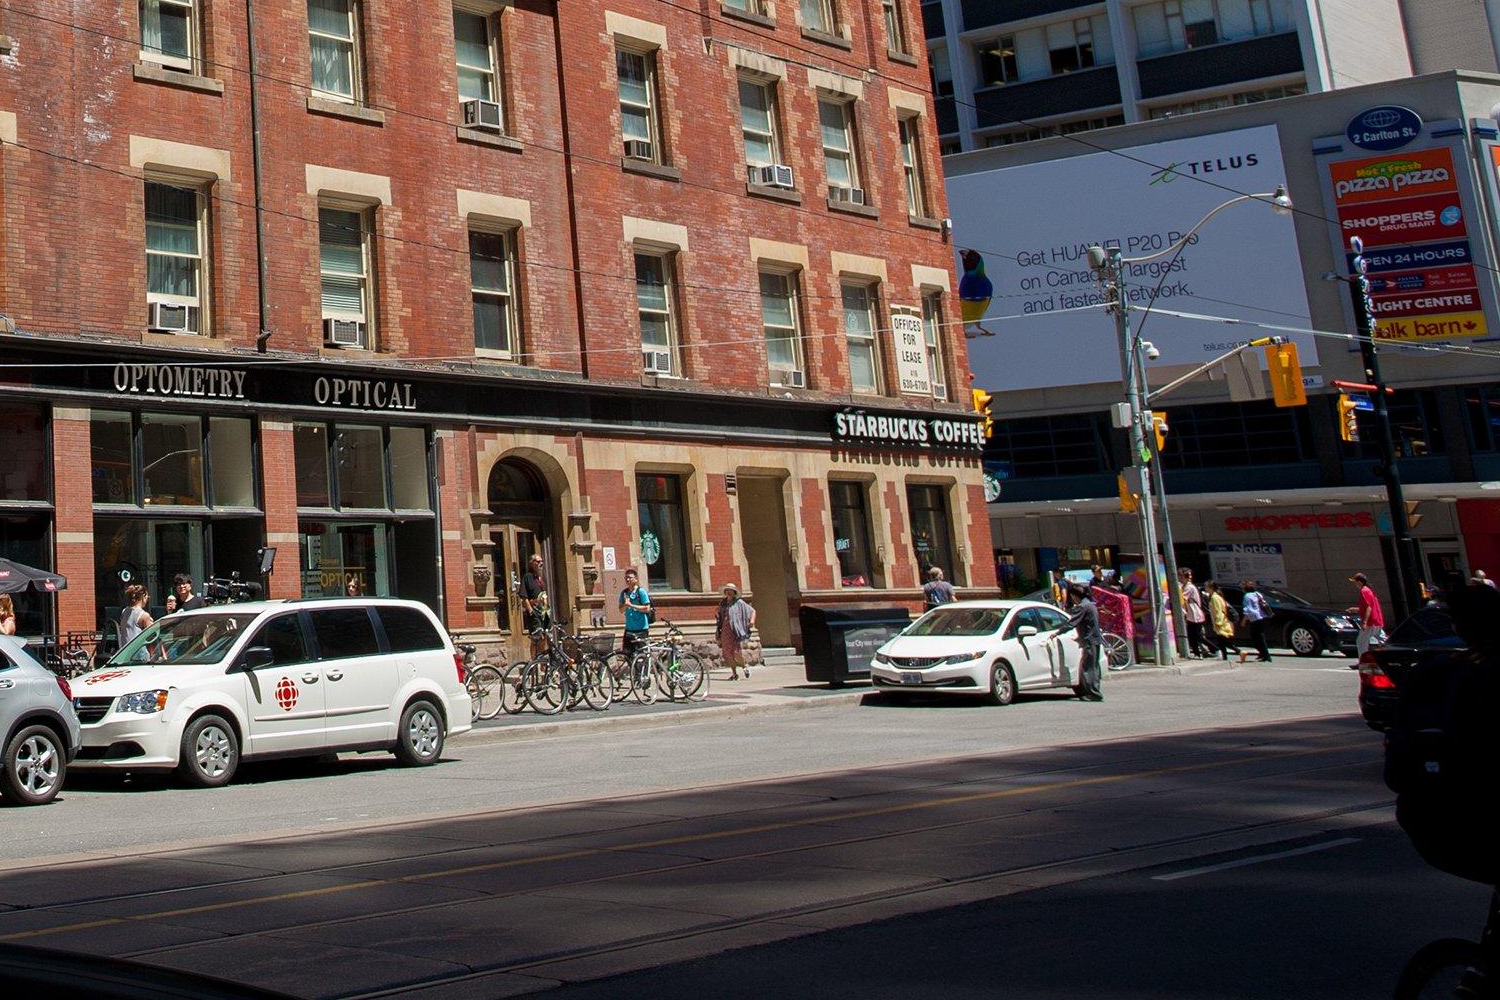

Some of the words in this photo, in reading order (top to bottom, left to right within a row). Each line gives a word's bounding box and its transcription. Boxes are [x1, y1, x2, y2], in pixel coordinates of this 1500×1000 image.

[1353, 134, 1360, 143] 2
[1363, 128, 1399, 143] Carlton
[1402, 127, 1416, 138] St.
[1188, 153, 1258, 175] TELUS
[1355, 167, 1378, 178] Hot
[1388, 160, 1421, 173] Fresh
[1342, 210, 1436, 229] SHOPPERS
[1379, 223, 1407, 232] DRUG
[1408, 220, 1436, 229] MART
[1016, 250, 1046, 268] Get
[1127, 234, 1162, 252] P20
[1365, 256, 1391, 266] PEN
[1395, 254, 1411, 263] 24
[1414, 248, 1466, 261] HOURS
[1020, 276, 1041, 290] on
[1128, 256, 1187, 278] largest
[1023, 294, 1053, 313] and
[1369, 300, 1412, 313] LIGHT
[1414, 295, 1473, 309] CENTRE
[894, 317, 921, 332] OFFICES
[1376, 322, 1408, 339] ulk
[1413, 320, 1461, 337] barn
[903, 333, 916, 346] FOR
[902, 351, 922, 364] LEASE
[113, 362, 247, 398] OPTOMETRY
[902, 378, 928, 391] 630-6700
[314, 377, 416, 409] OPTICAL
[836, 412, 928, 442] STARBUCKS
[934, 420, 986, 445] COFFEE
[1224, 511, 1375, 532] SHOPPERS
[1232, 543, 1277, 554] Notice
